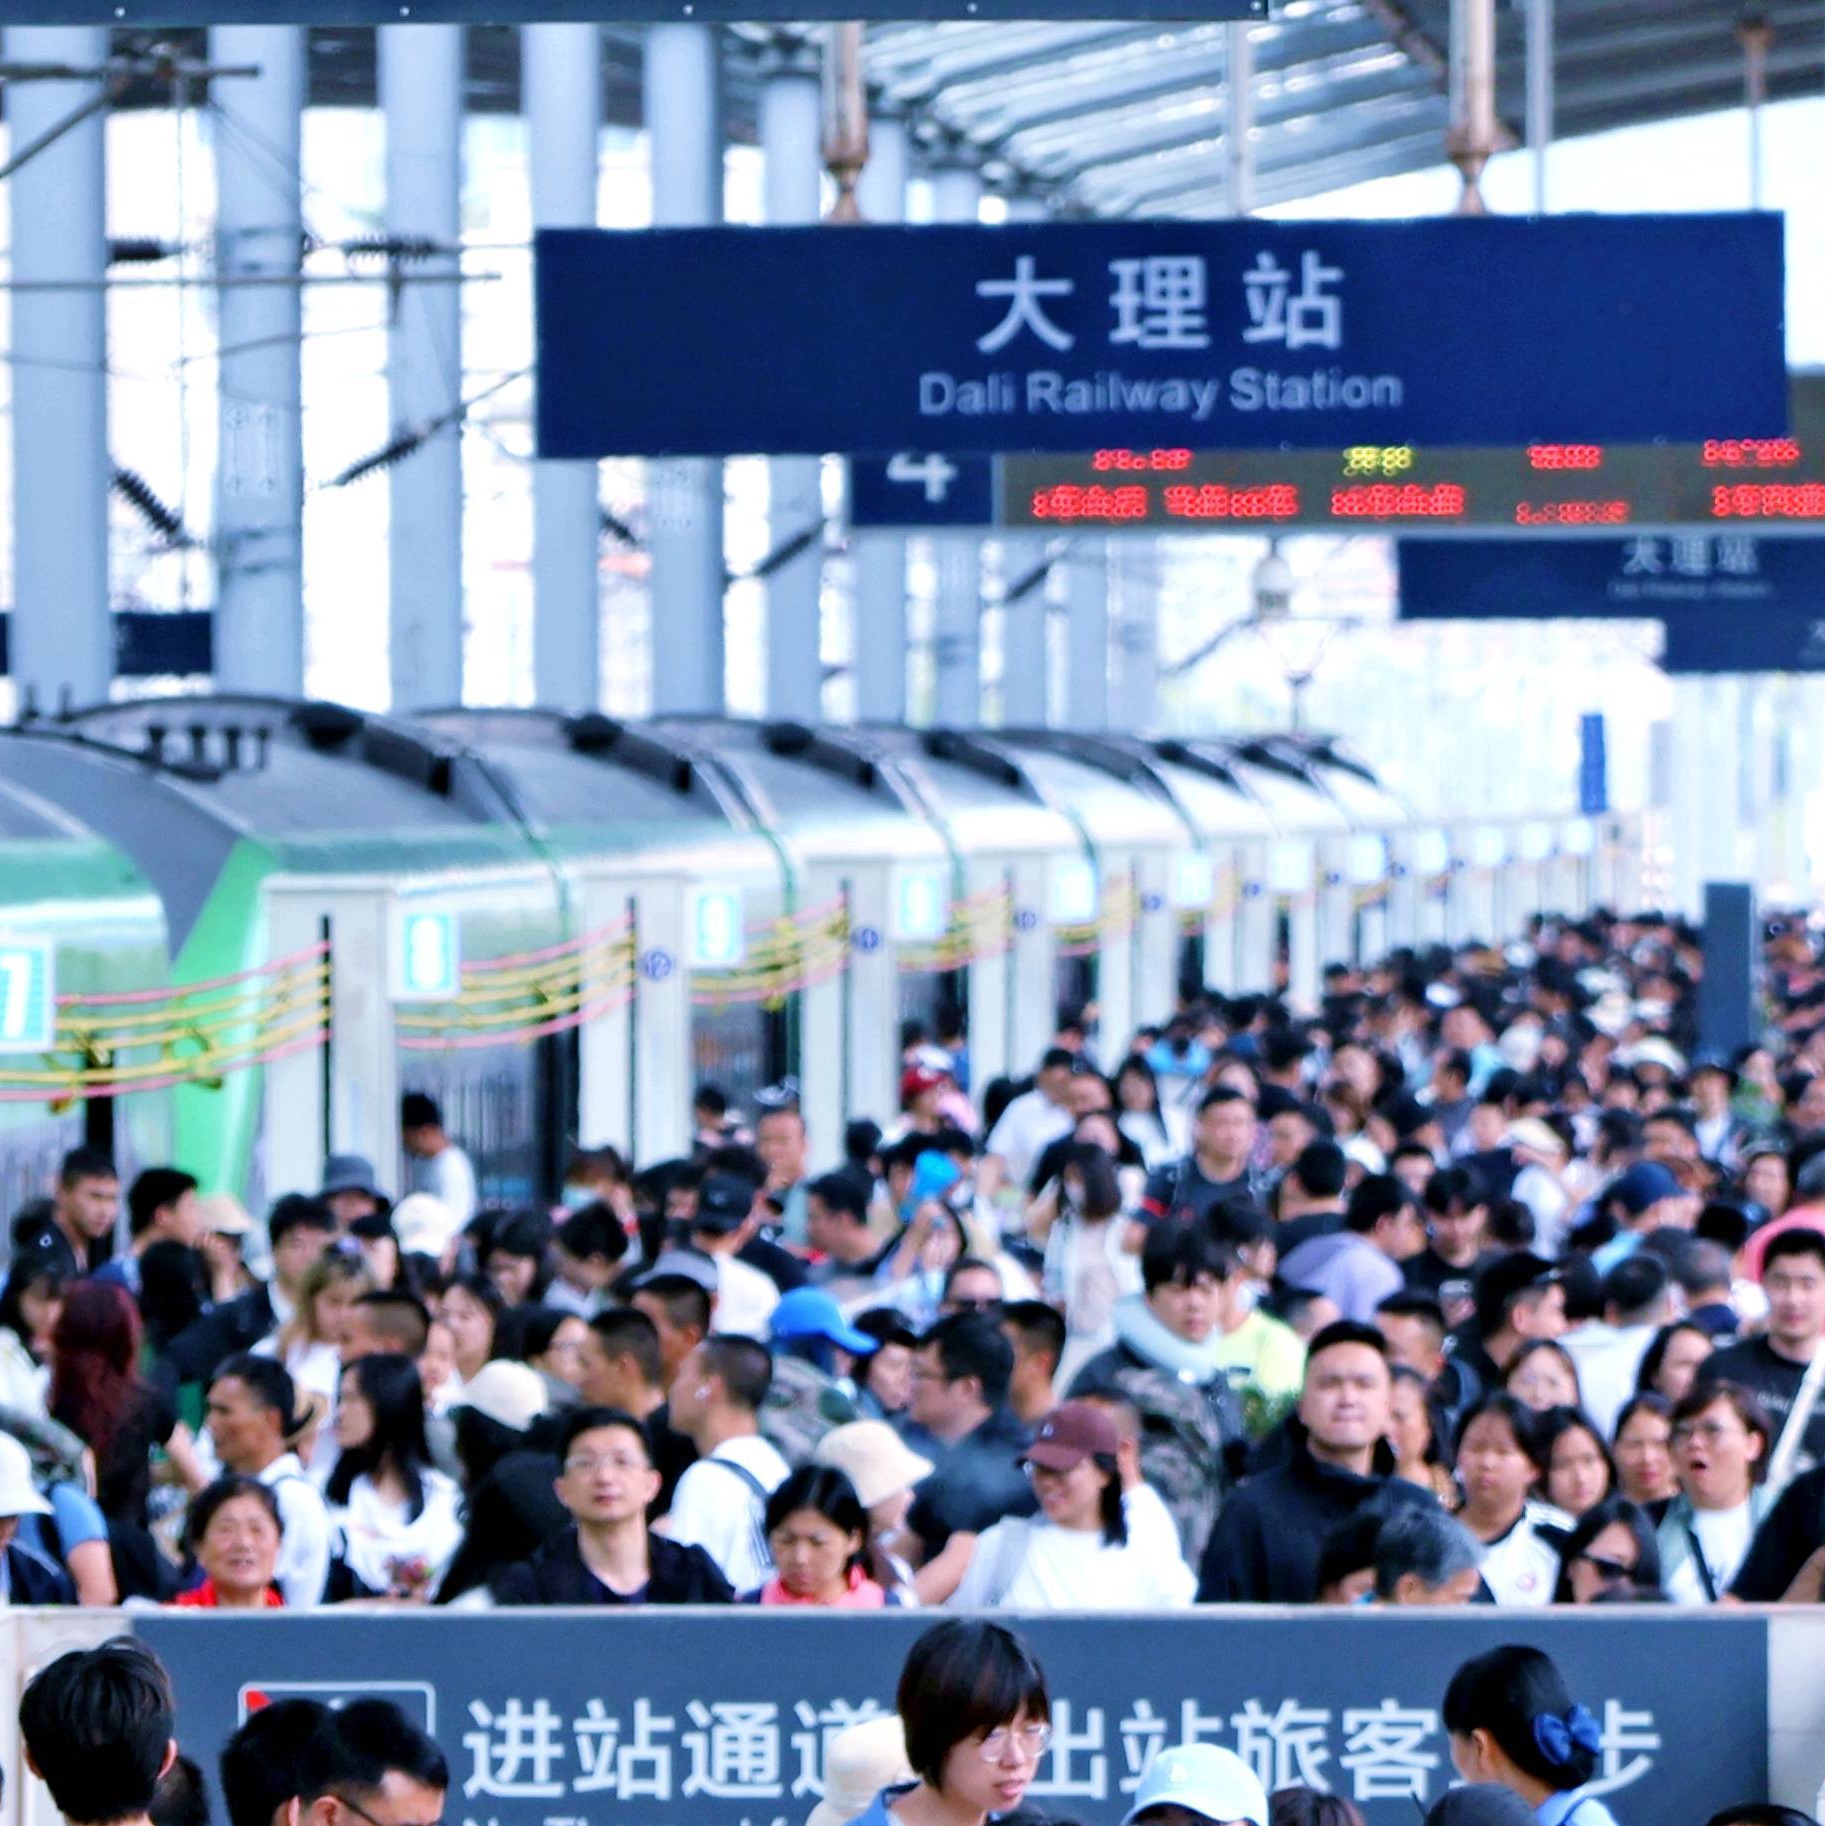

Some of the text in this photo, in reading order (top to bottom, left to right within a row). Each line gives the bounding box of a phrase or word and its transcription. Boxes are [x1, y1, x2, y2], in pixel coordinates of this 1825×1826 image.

[976, 251, 1344, 351] 大理站
[920, 366, 1403, 422] Dali Railway Station
[0, 952, 32, 1039] 7
[1042, 1698, 1662, 1801] 出站旅客步
